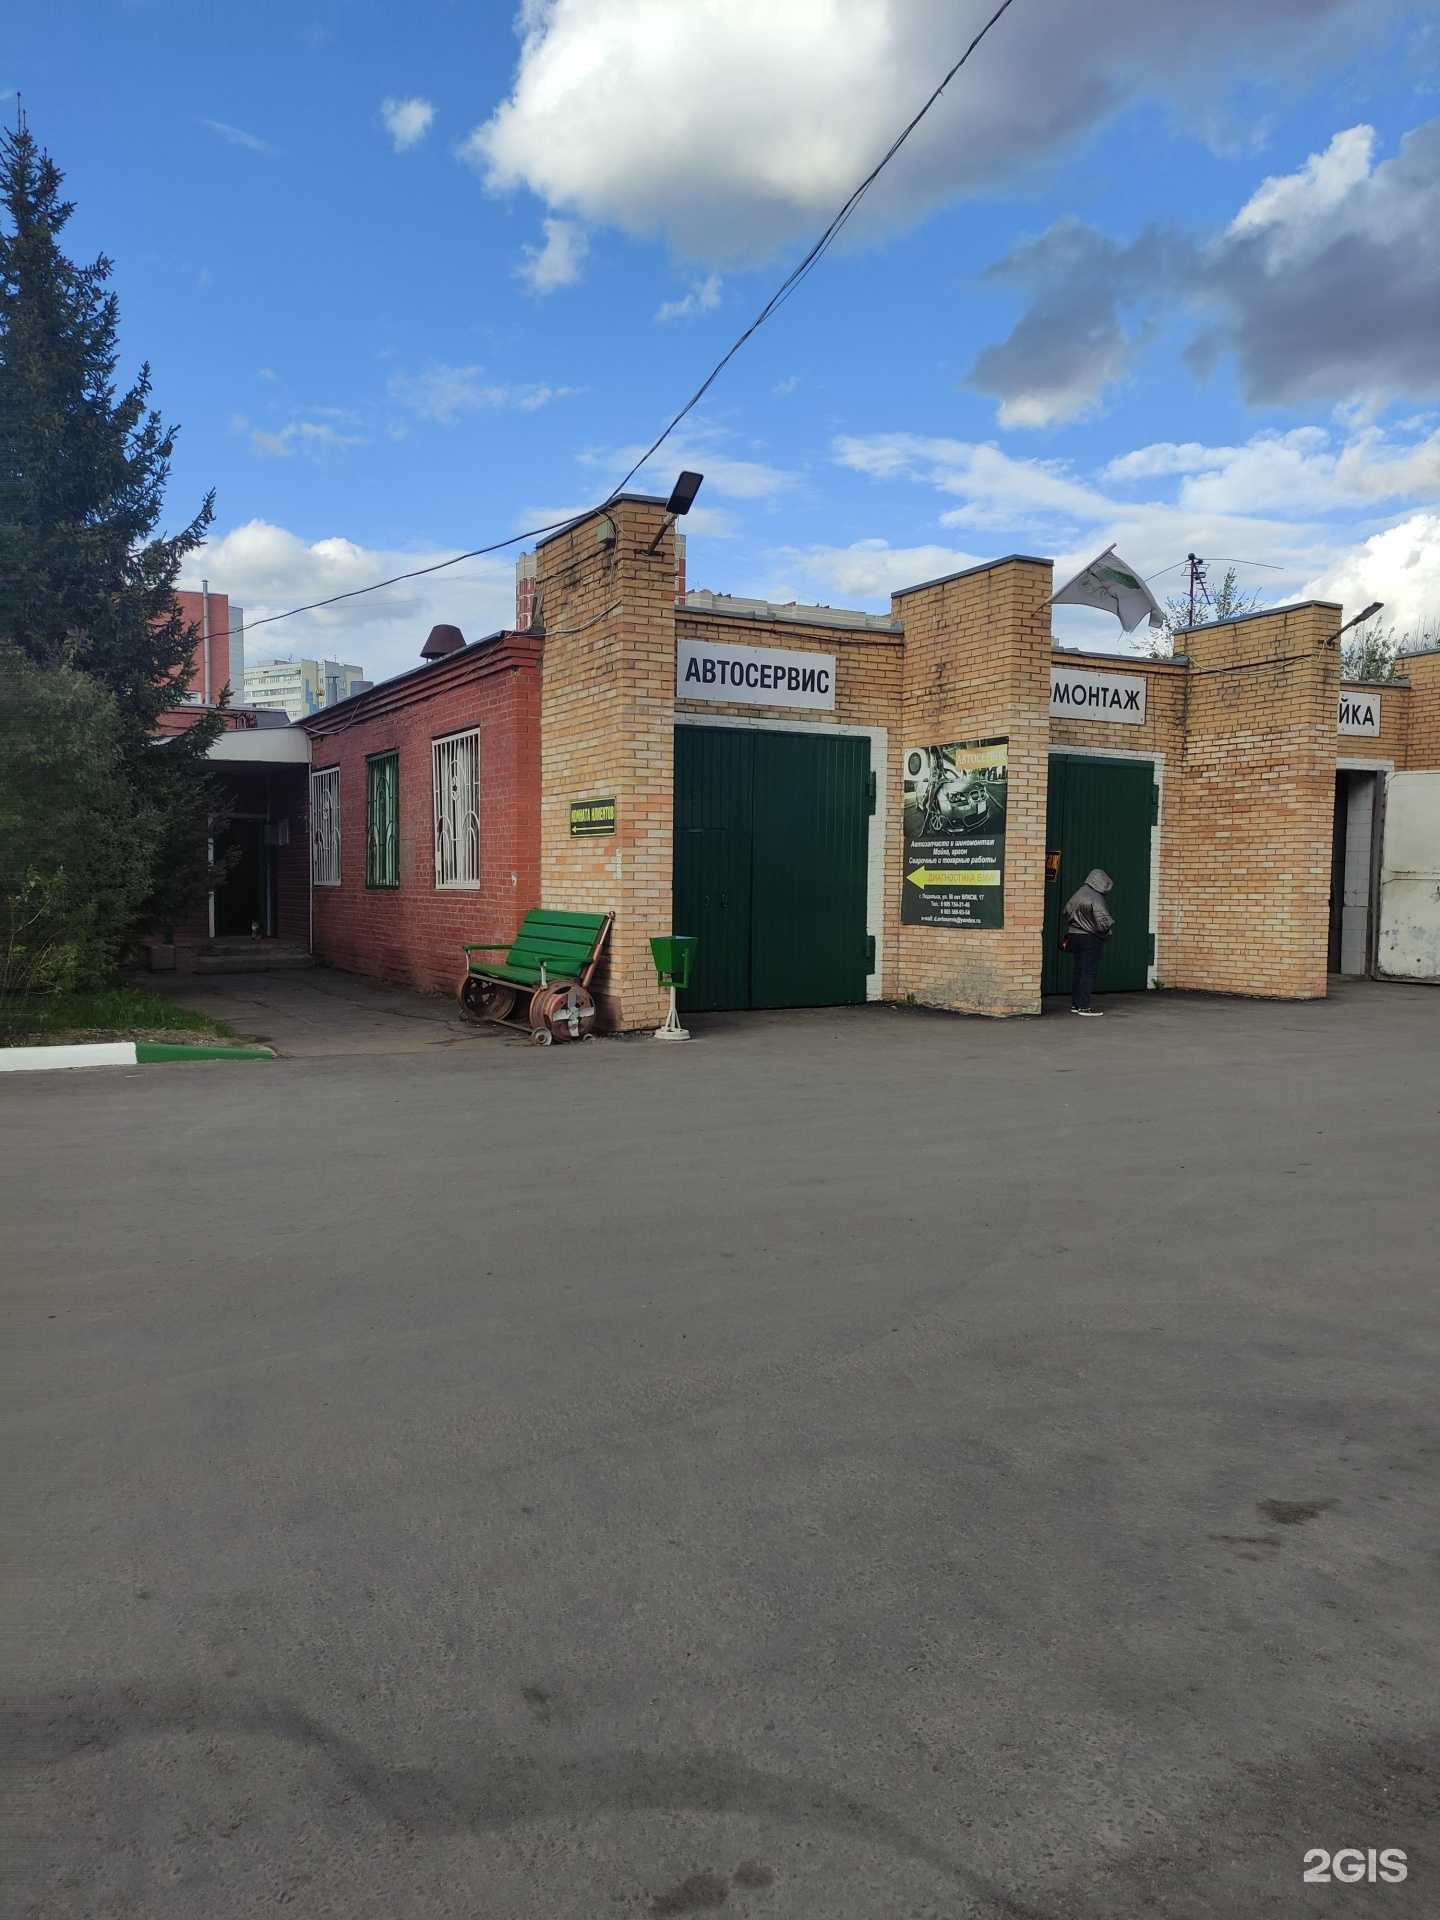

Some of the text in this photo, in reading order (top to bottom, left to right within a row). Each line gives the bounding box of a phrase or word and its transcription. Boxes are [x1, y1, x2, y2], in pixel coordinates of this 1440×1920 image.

[684, 657, 830, 694] АВТОСЕРВИС
[1052, 682, 1140, 711] МОНТАЖ
[1338, 697, 1375, 727] ЙКА
